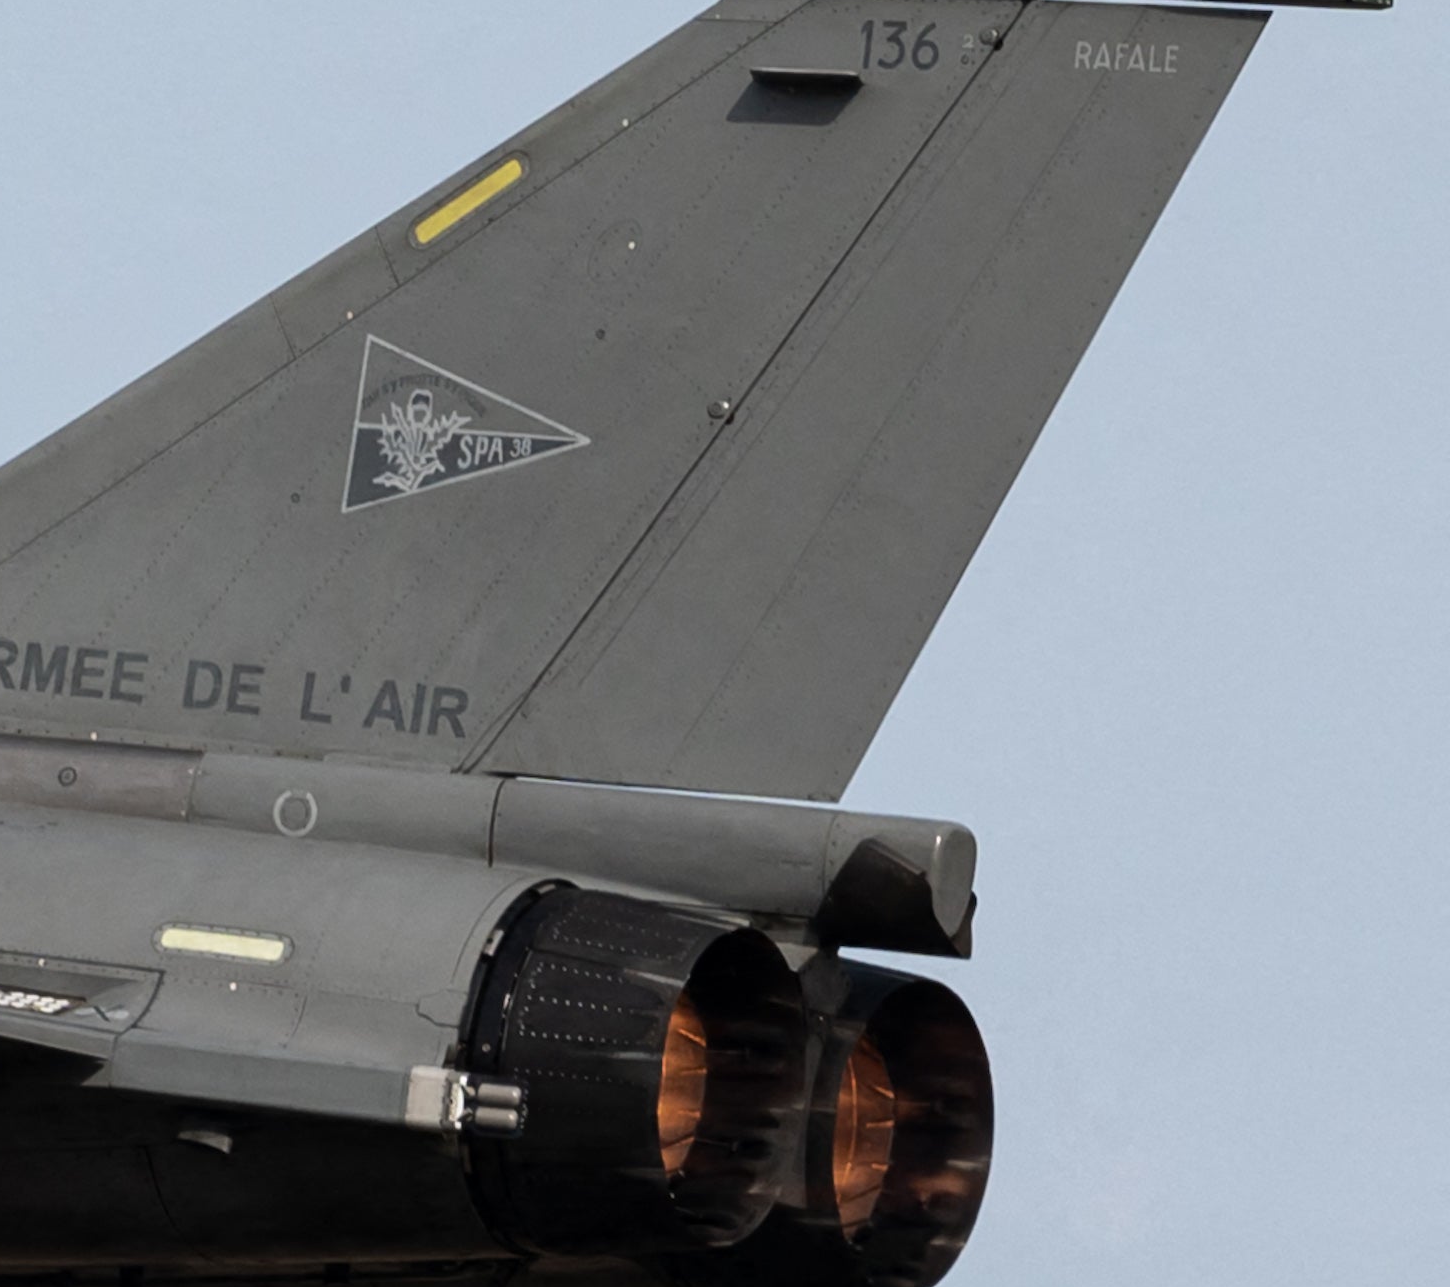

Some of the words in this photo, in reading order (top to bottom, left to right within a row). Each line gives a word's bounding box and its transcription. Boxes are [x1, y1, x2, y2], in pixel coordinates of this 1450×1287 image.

[859, 19, 940, 71] 136
[961, 32, 976, 49] 2
[1074, 40, 1180, 74] RAFALE
[457, 434, 503, 469] SPA
[510, 437, 533, 458] 38
[182, 658, 264, 716] DE
